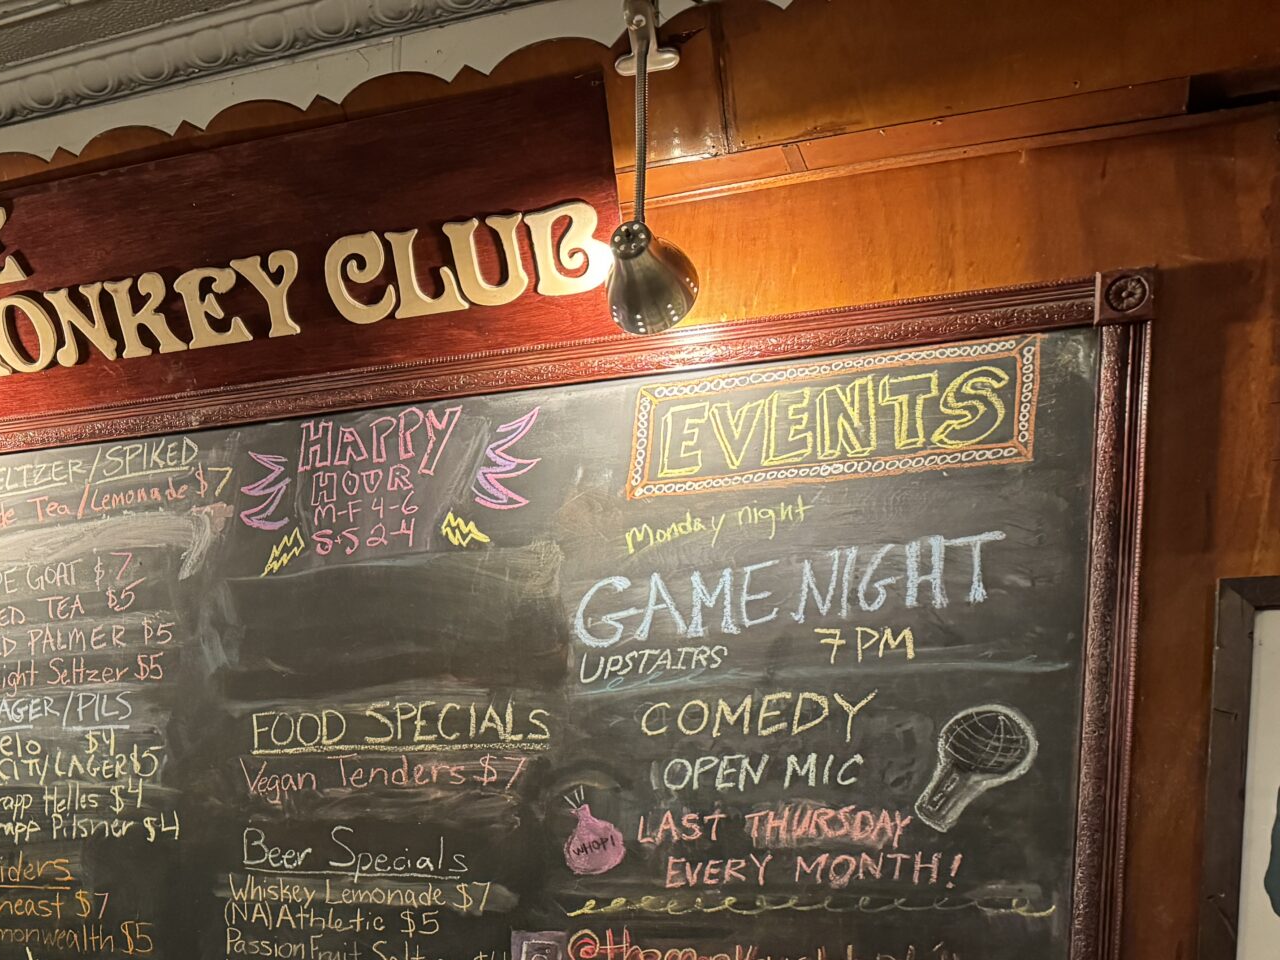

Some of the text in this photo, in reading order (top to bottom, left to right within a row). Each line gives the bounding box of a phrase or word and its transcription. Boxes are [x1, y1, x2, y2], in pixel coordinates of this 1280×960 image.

[325, 201, 613, 324] CLUB
[298, 405, 462, 476] HAPPY
[657, 365, 1009, 479] EVENTS
[195, 461, 234, 497] $7
[311, 464, 413, 506] HOUR
[315, 491, 419, 526] M-F 4-6
[624, 494, 814, 555] Monday night
[366, 518, 415, 547] 2-4
[26, 558, 83, 591] GOAT
[573, 530, 1006, 649] GAME NIGHT
[36, 594, 85, 619] TEA
[106, 576, 147, 611] $5
[27, 624, 126, 656] PALMER
[142, 616, 175, 645] $5
[579, 645, 728, 683] UPSTAIRS
[855, 625, 916, 664] PM
[47, 657, 128, 685] Seltzer
[134, 652, 164, 680] $5
[252, 700, 551, 748] FOOD SPECIALS
[641, 688, 879, 743] COMEDY
[54, 748, 127, 779] LAGER
[130, 744, 164, 777] $5
[85, 728, 115, 756] $4
[239, 753, 528, 804] Vegan Tenders $7
[663, 752, 865, 792] OPEN MIC
[43, 780, 99, 816] Helles
[110, 778, 143, 814] $4
[52, 813, 134, 840] Pilsner
[143, 811, 180, 842] $4
[638, 803, 912, 847] LAST THURSDAY
[243, 825, 469, 883] Beer Specials
[665, 851, 963, 889] EVERY MONTH!
[75, 890, 110, 920] $7
[228, 873, 492, 912] Whiskey Lemonade $7
[120, 920, 154, 954] $5
[224, 901, 440, 938] (NA) Athletic $5
